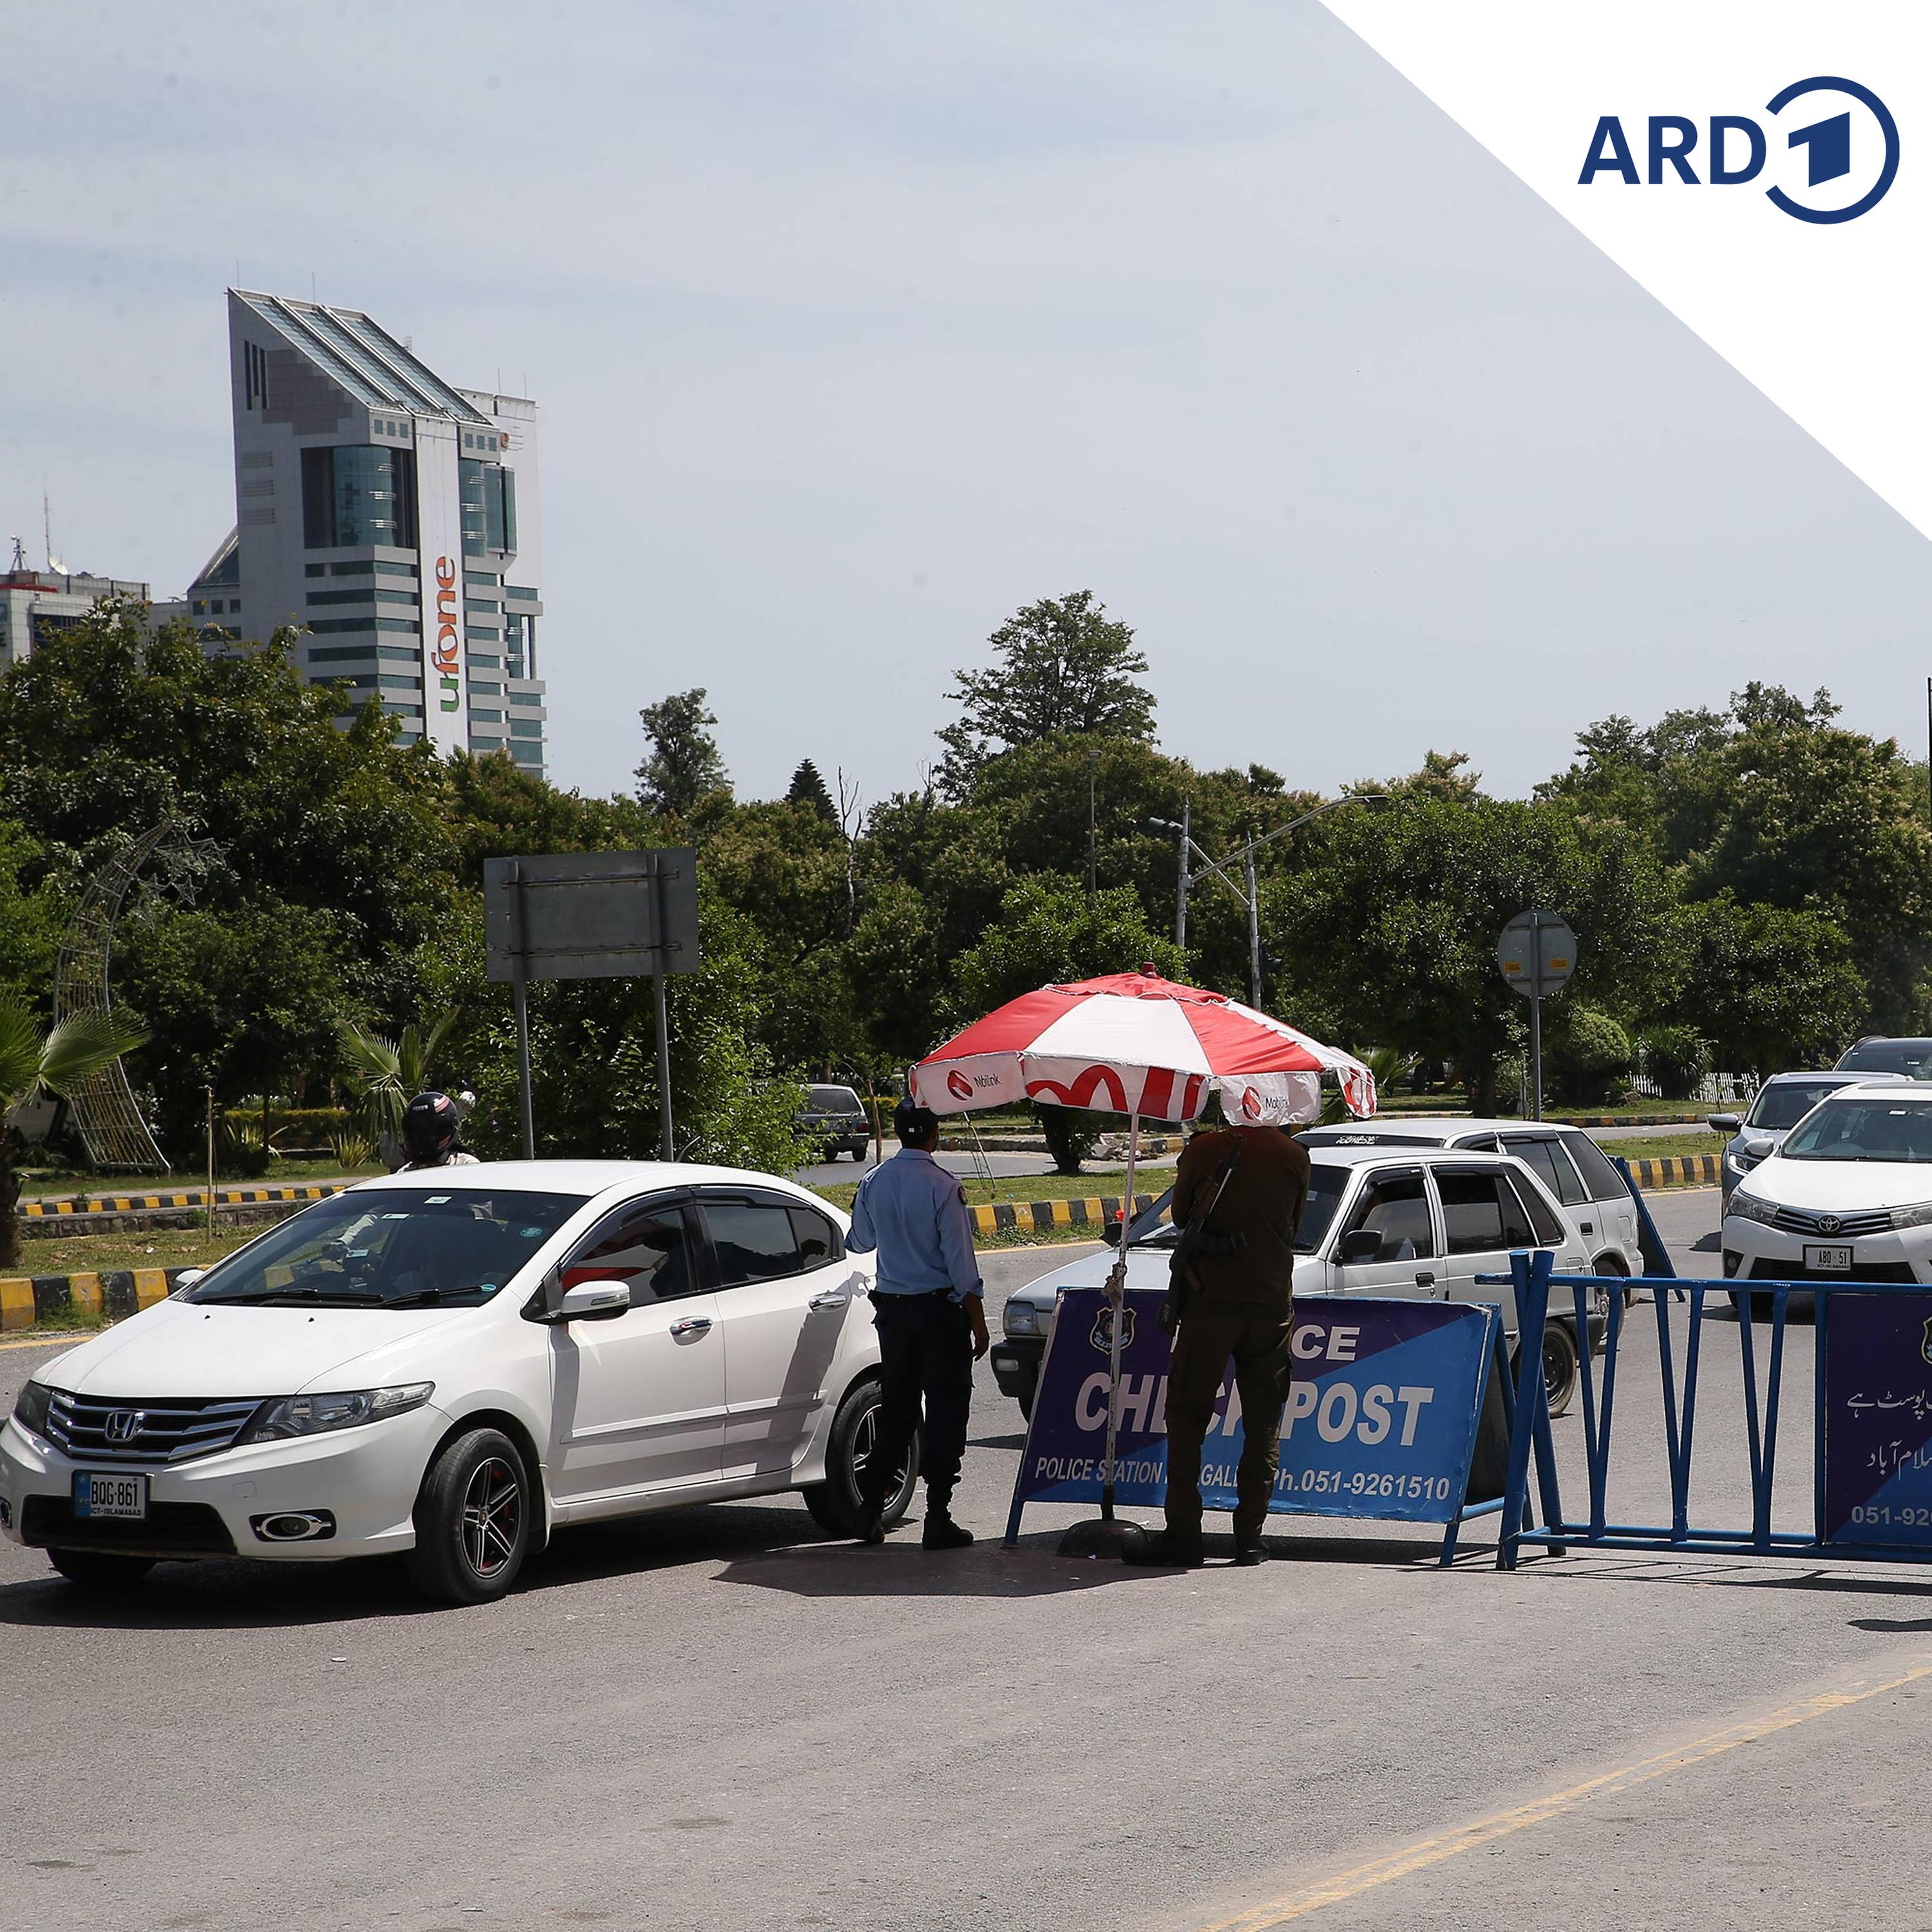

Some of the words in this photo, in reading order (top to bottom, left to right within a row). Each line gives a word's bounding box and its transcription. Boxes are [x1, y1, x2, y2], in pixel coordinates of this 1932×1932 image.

[431, 556, 460, 712] ufone
[1278, 1380, 1435, 1446] POST
[1035, 1457, 1094, 1481] POLICE
[1095, 1459, 1164, 1484] STATION
[1851, 1506, 1932, 1526] 051-92
